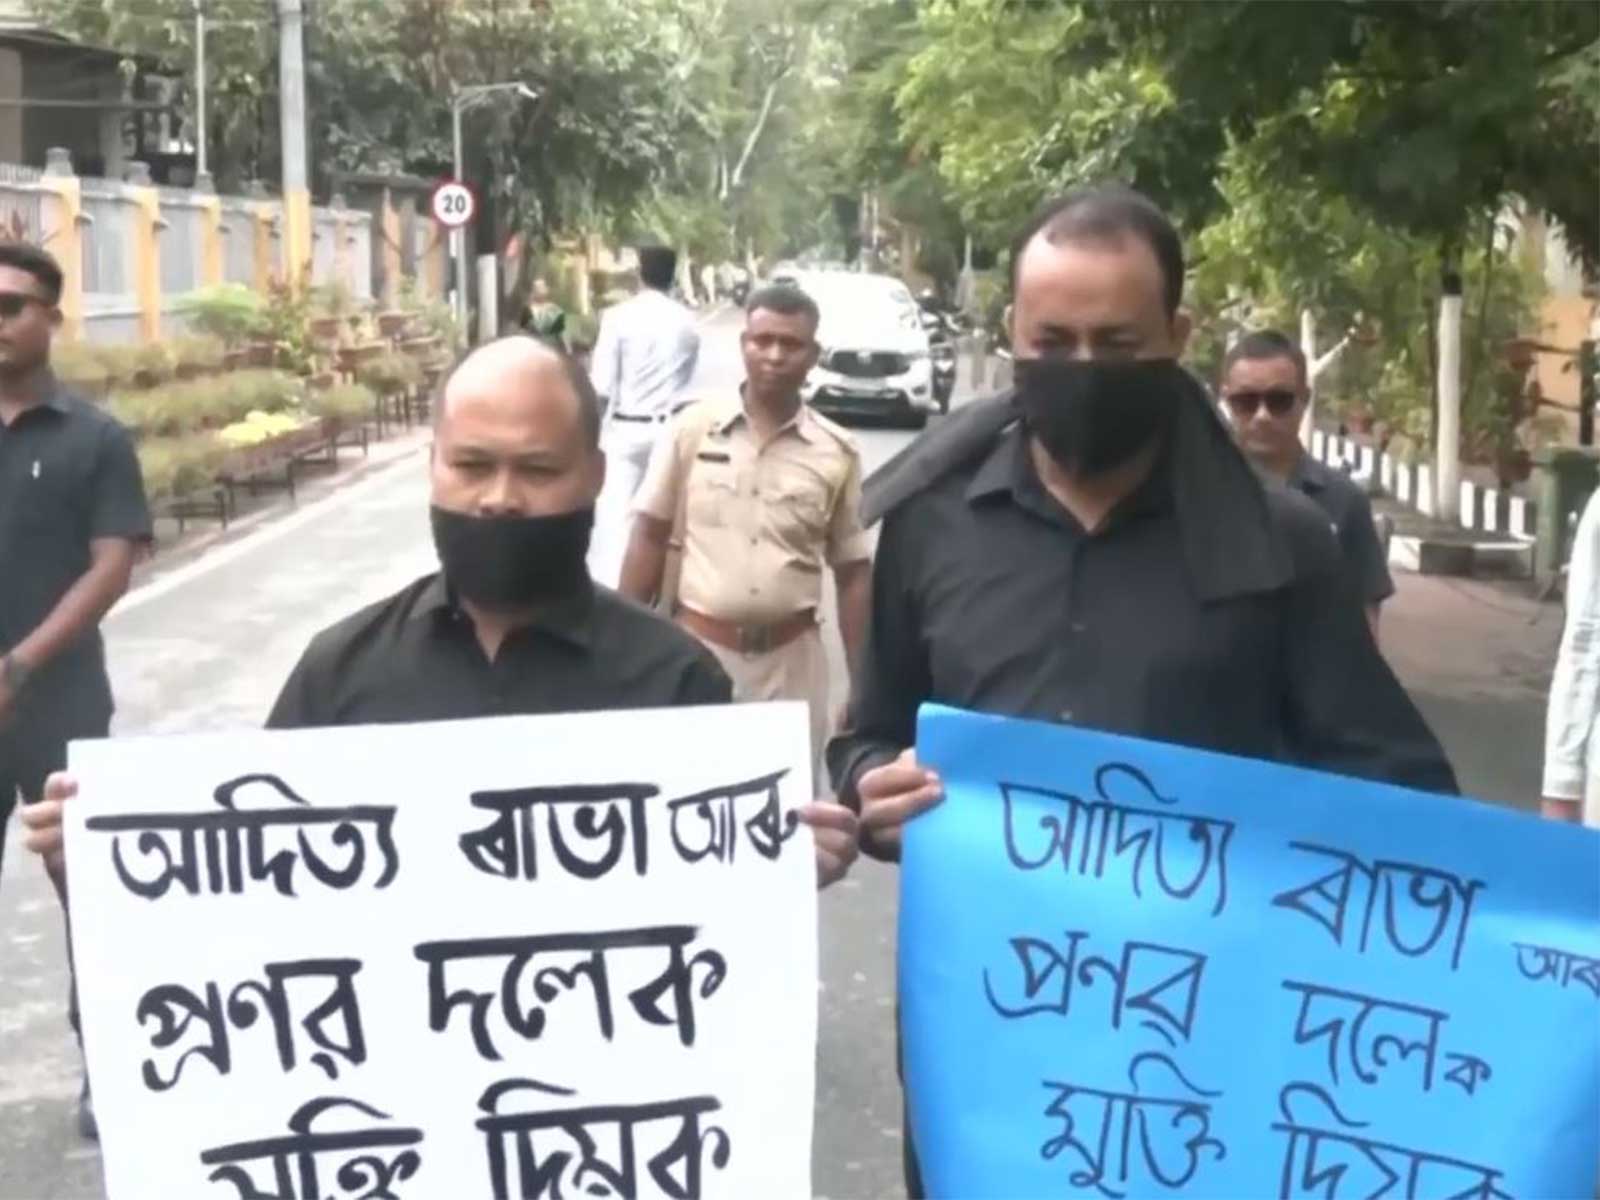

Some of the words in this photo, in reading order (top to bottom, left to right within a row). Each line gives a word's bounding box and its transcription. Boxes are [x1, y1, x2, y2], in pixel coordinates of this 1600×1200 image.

[442, 193, 467, 215] 20
[86, 773, 400, 900] আদিত্য
[459, 782, 661, 881] ৰাভা
[1000, 763, 1236, 917] আদিত্য
[1271, 840, 1487, 970] ৰাভা
[1510, 941, 1600, 1000] আৰ
[413, 923, 727, 1062] দলেক
[1040, 1051, 1224, 1199] মুক্তি
